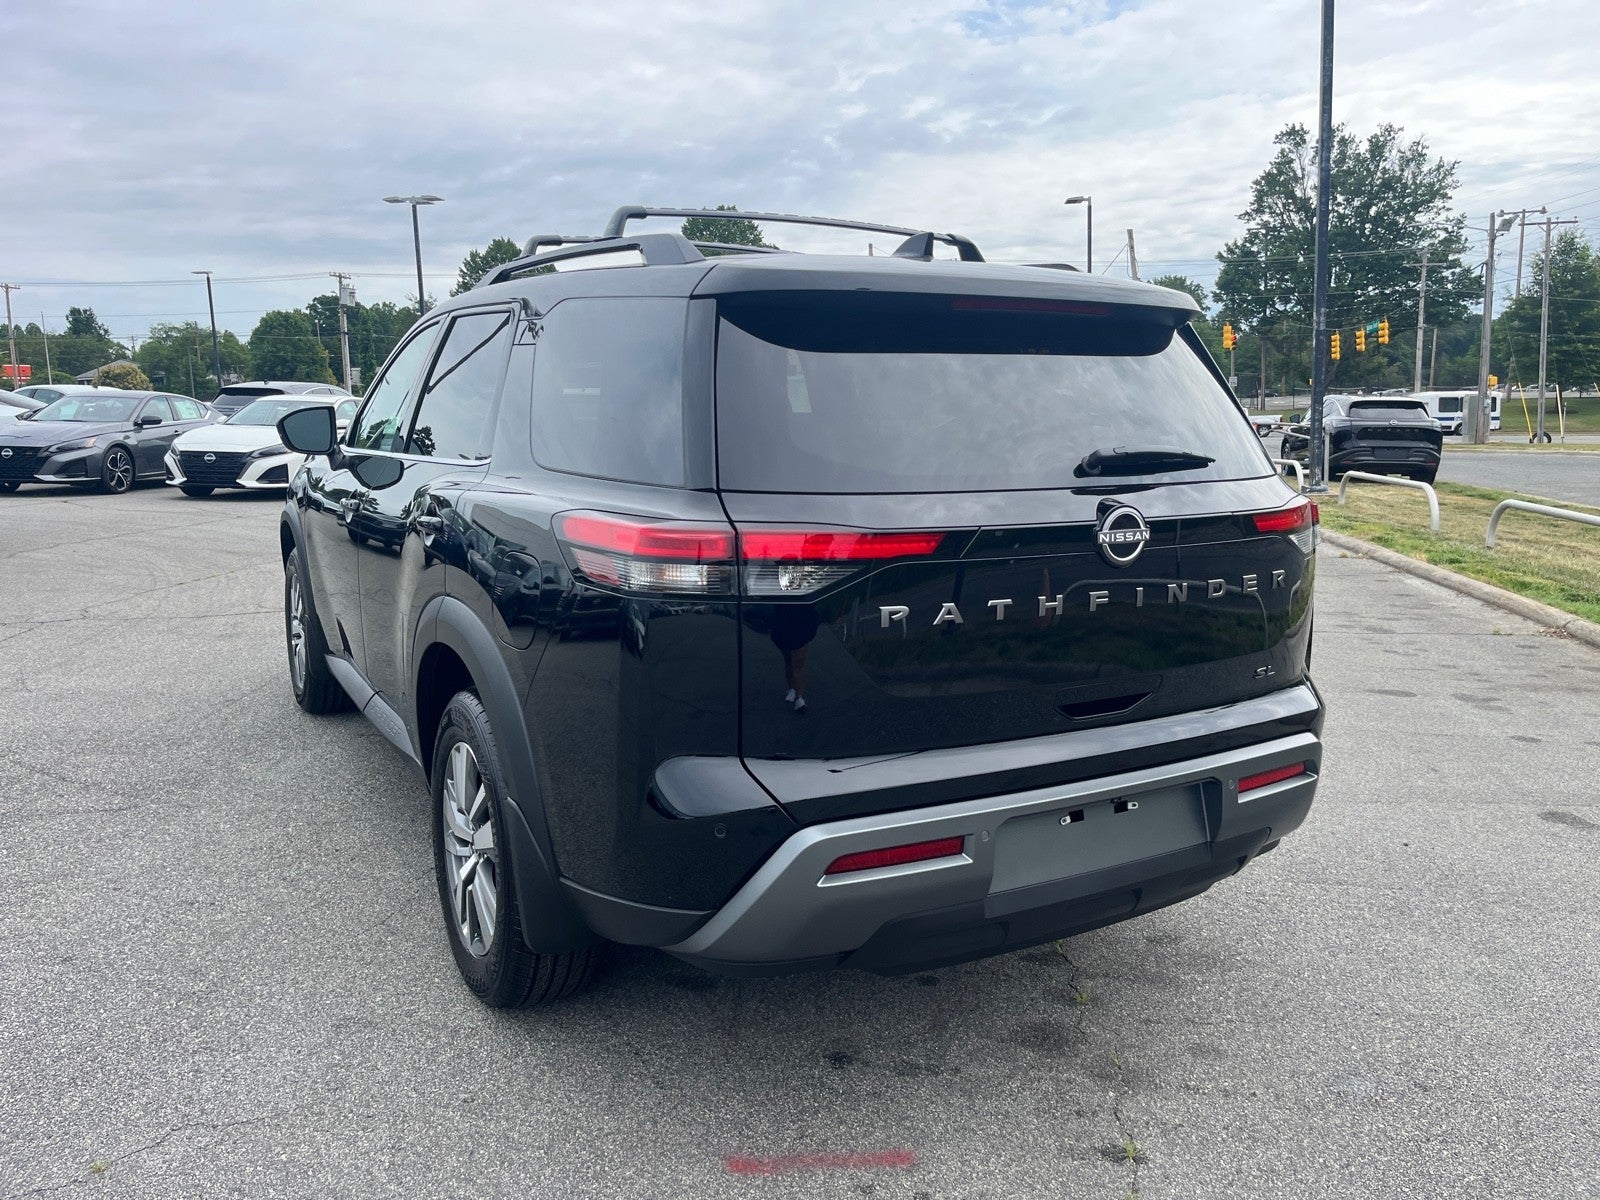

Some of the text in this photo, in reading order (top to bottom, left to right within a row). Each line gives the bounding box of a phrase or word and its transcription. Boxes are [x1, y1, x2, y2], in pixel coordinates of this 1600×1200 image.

[1098, 530, 1150, 543] NISSAN
[879, 568, 1287, 628] PATHFINDER
[1254, 665, 1276, 679] SL
